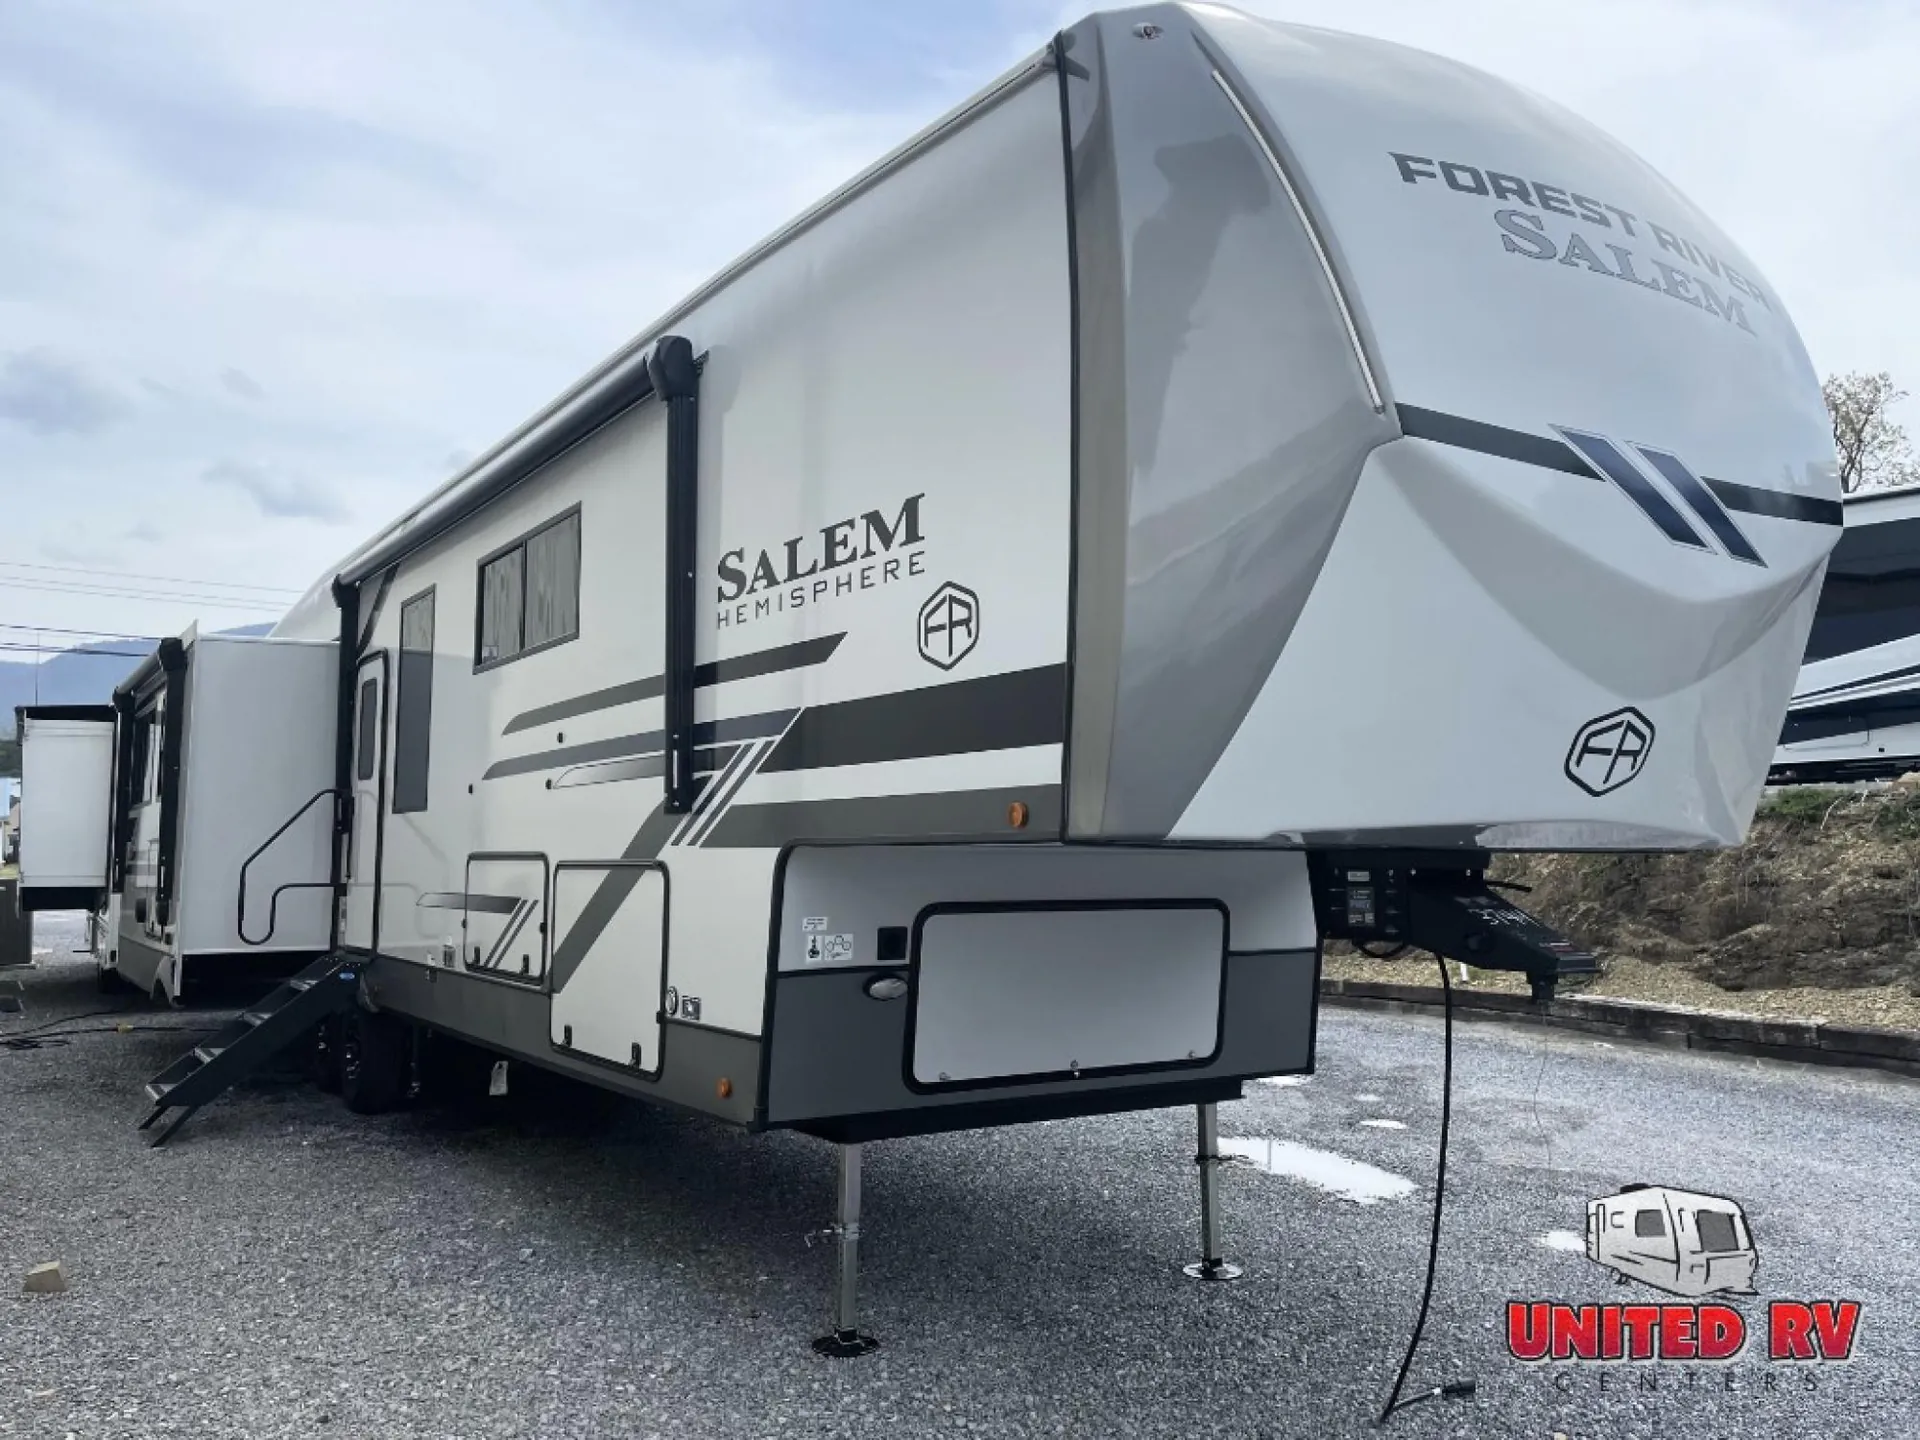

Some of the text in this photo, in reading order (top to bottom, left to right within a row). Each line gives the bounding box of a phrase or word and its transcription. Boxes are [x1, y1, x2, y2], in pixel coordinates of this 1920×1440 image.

[1387, 151, 1773, 312] FOREST RIVER
[1494, 209, 1758, 337] SALEM
[716, 550, 926, 630] HEMISPHERE
[717, 493, 926, 604] SALEM
